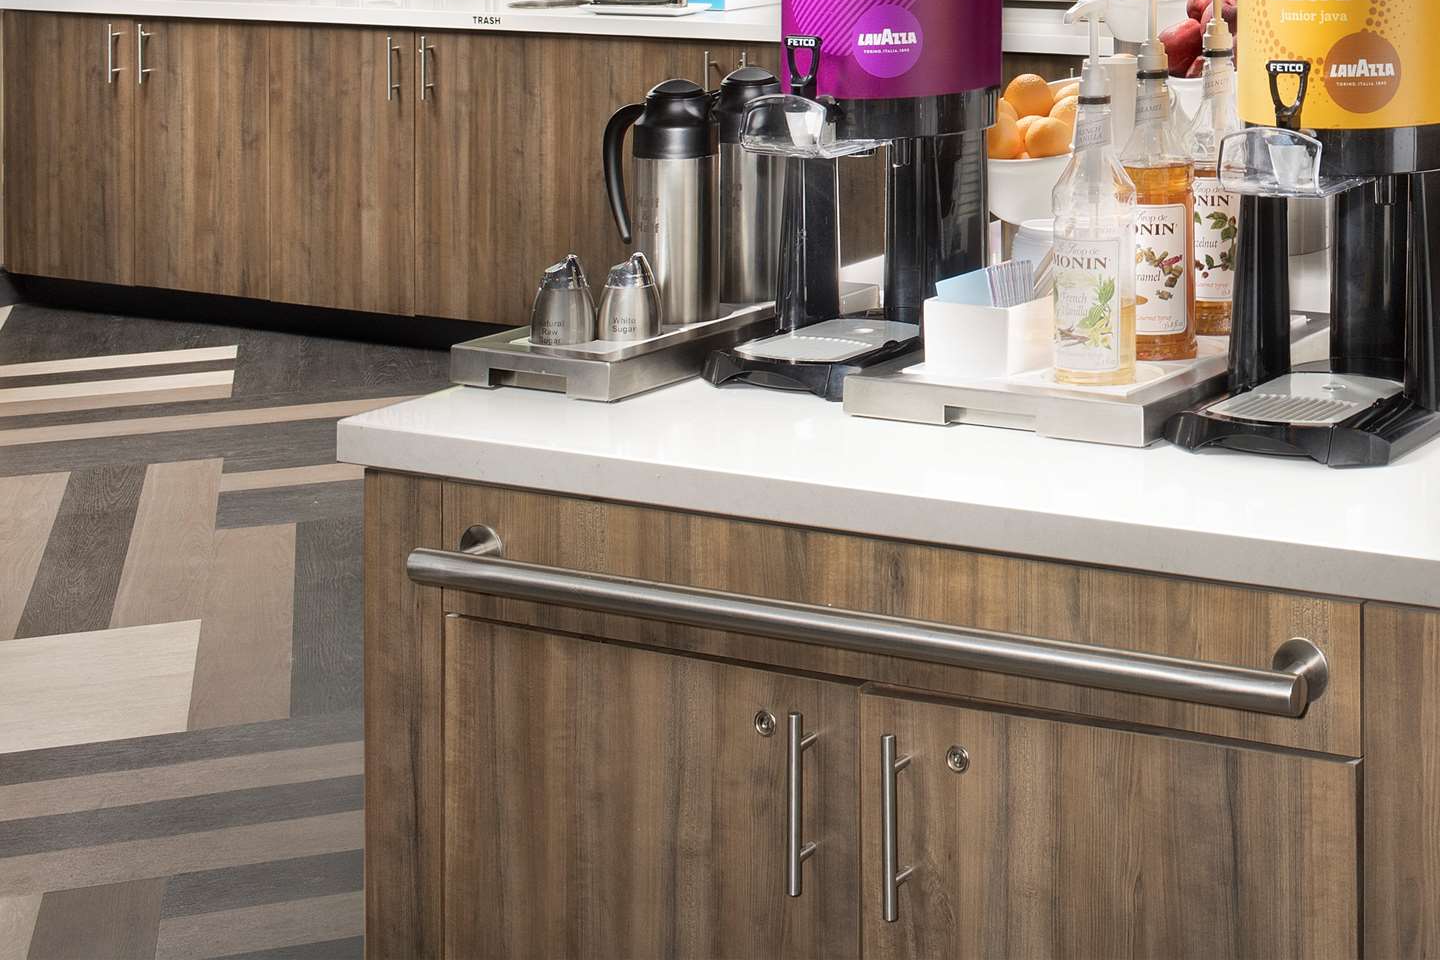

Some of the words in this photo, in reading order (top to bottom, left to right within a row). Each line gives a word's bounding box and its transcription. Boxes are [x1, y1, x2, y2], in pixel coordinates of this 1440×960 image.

[472, 16, 501, 25] TRASH
[1280, 10, 1317, 24] junior
[1319, 9, 1348, 25] java
[787, 37, 816, 47] FETCO
[858, 28, 917, 46] LAVAZZA
[1270, 63, 1304, 73] FETCO
[1329, 58, 1395, 78] LAVAZZA
[1194, 194, 1230, 207] NIN
[1135, 223, 1175, 236] ONIN
[1052, 254, 1108, 270] MONIN
[1136, 270, 1162, 283] ramel
